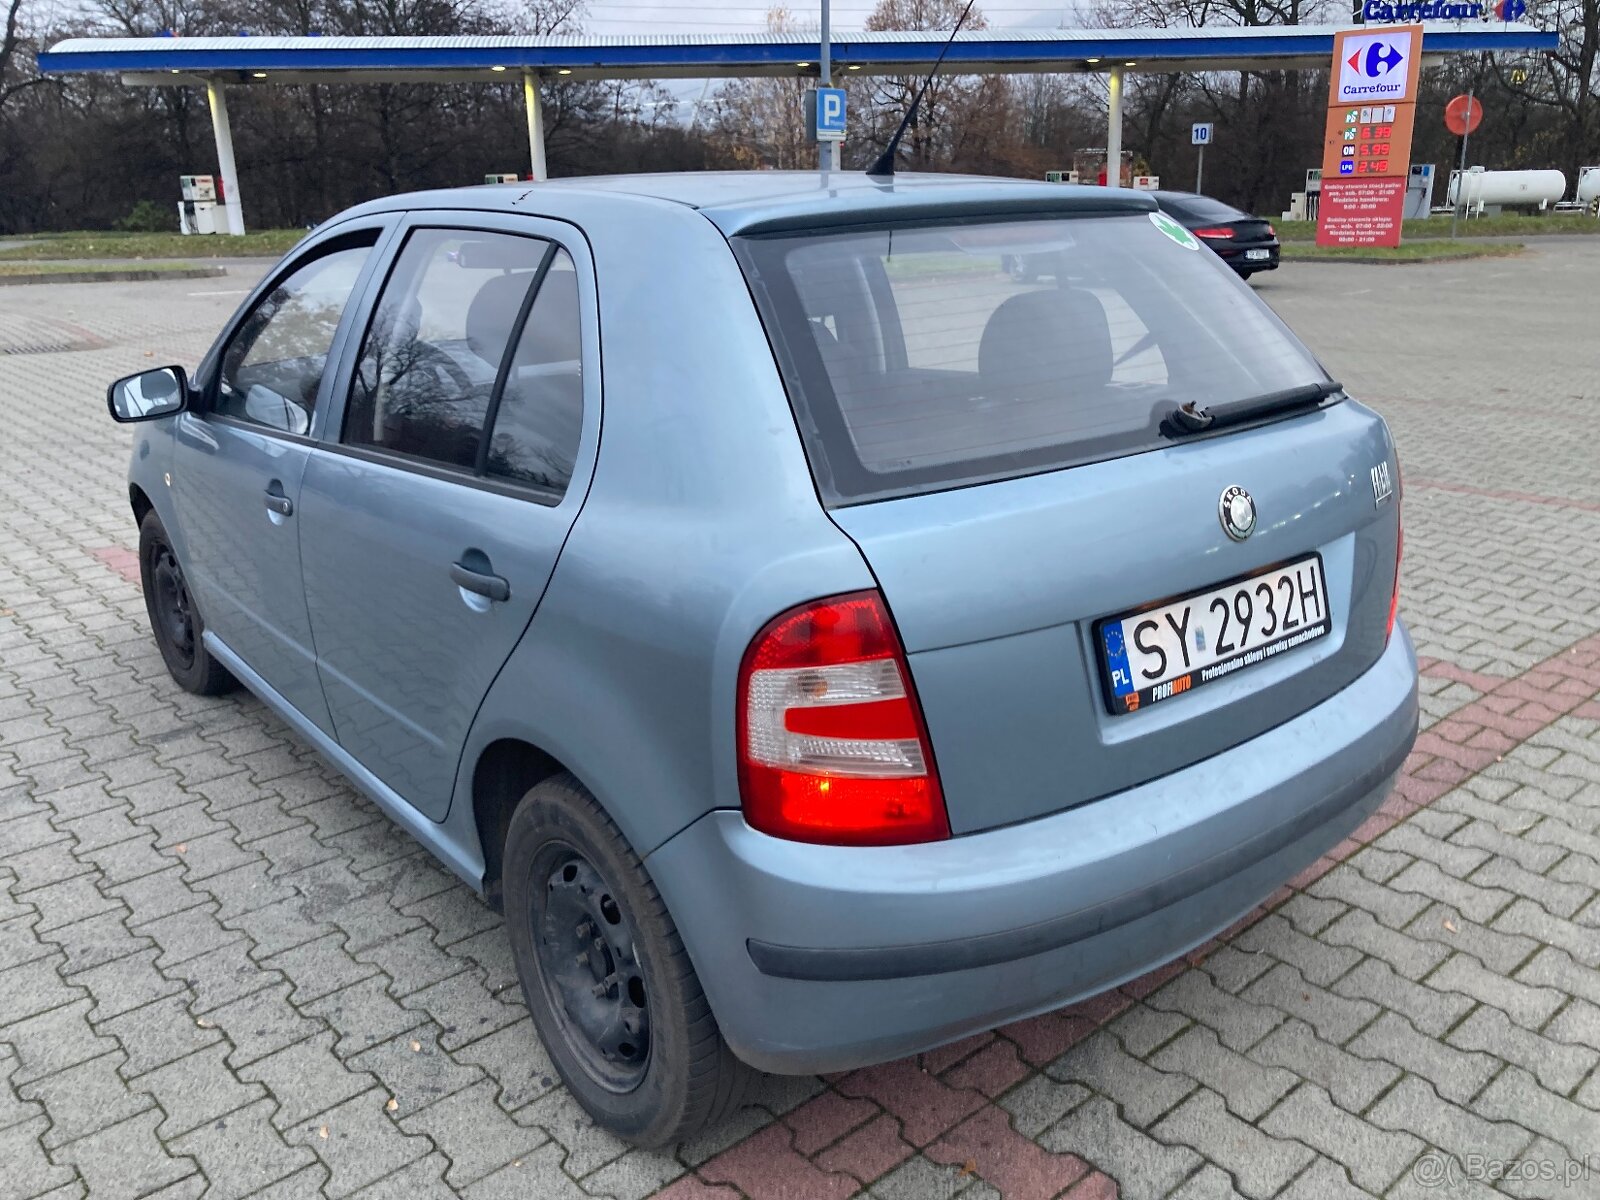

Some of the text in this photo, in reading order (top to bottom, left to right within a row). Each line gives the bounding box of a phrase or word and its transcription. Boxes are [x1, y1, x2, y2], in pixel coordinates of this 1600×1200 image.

[1364, 0, 1483, 20] Carrefour
[1343, 83, 1401, 95] Carrefour
[823, 94, 841, 126] P
[1194, 127, 1207, 140] 10
[1343, 146, 1355, 156] ON
[1133, 565, 1321, 680] SY 2932H
[1111, 668, 1130, 688] PL
